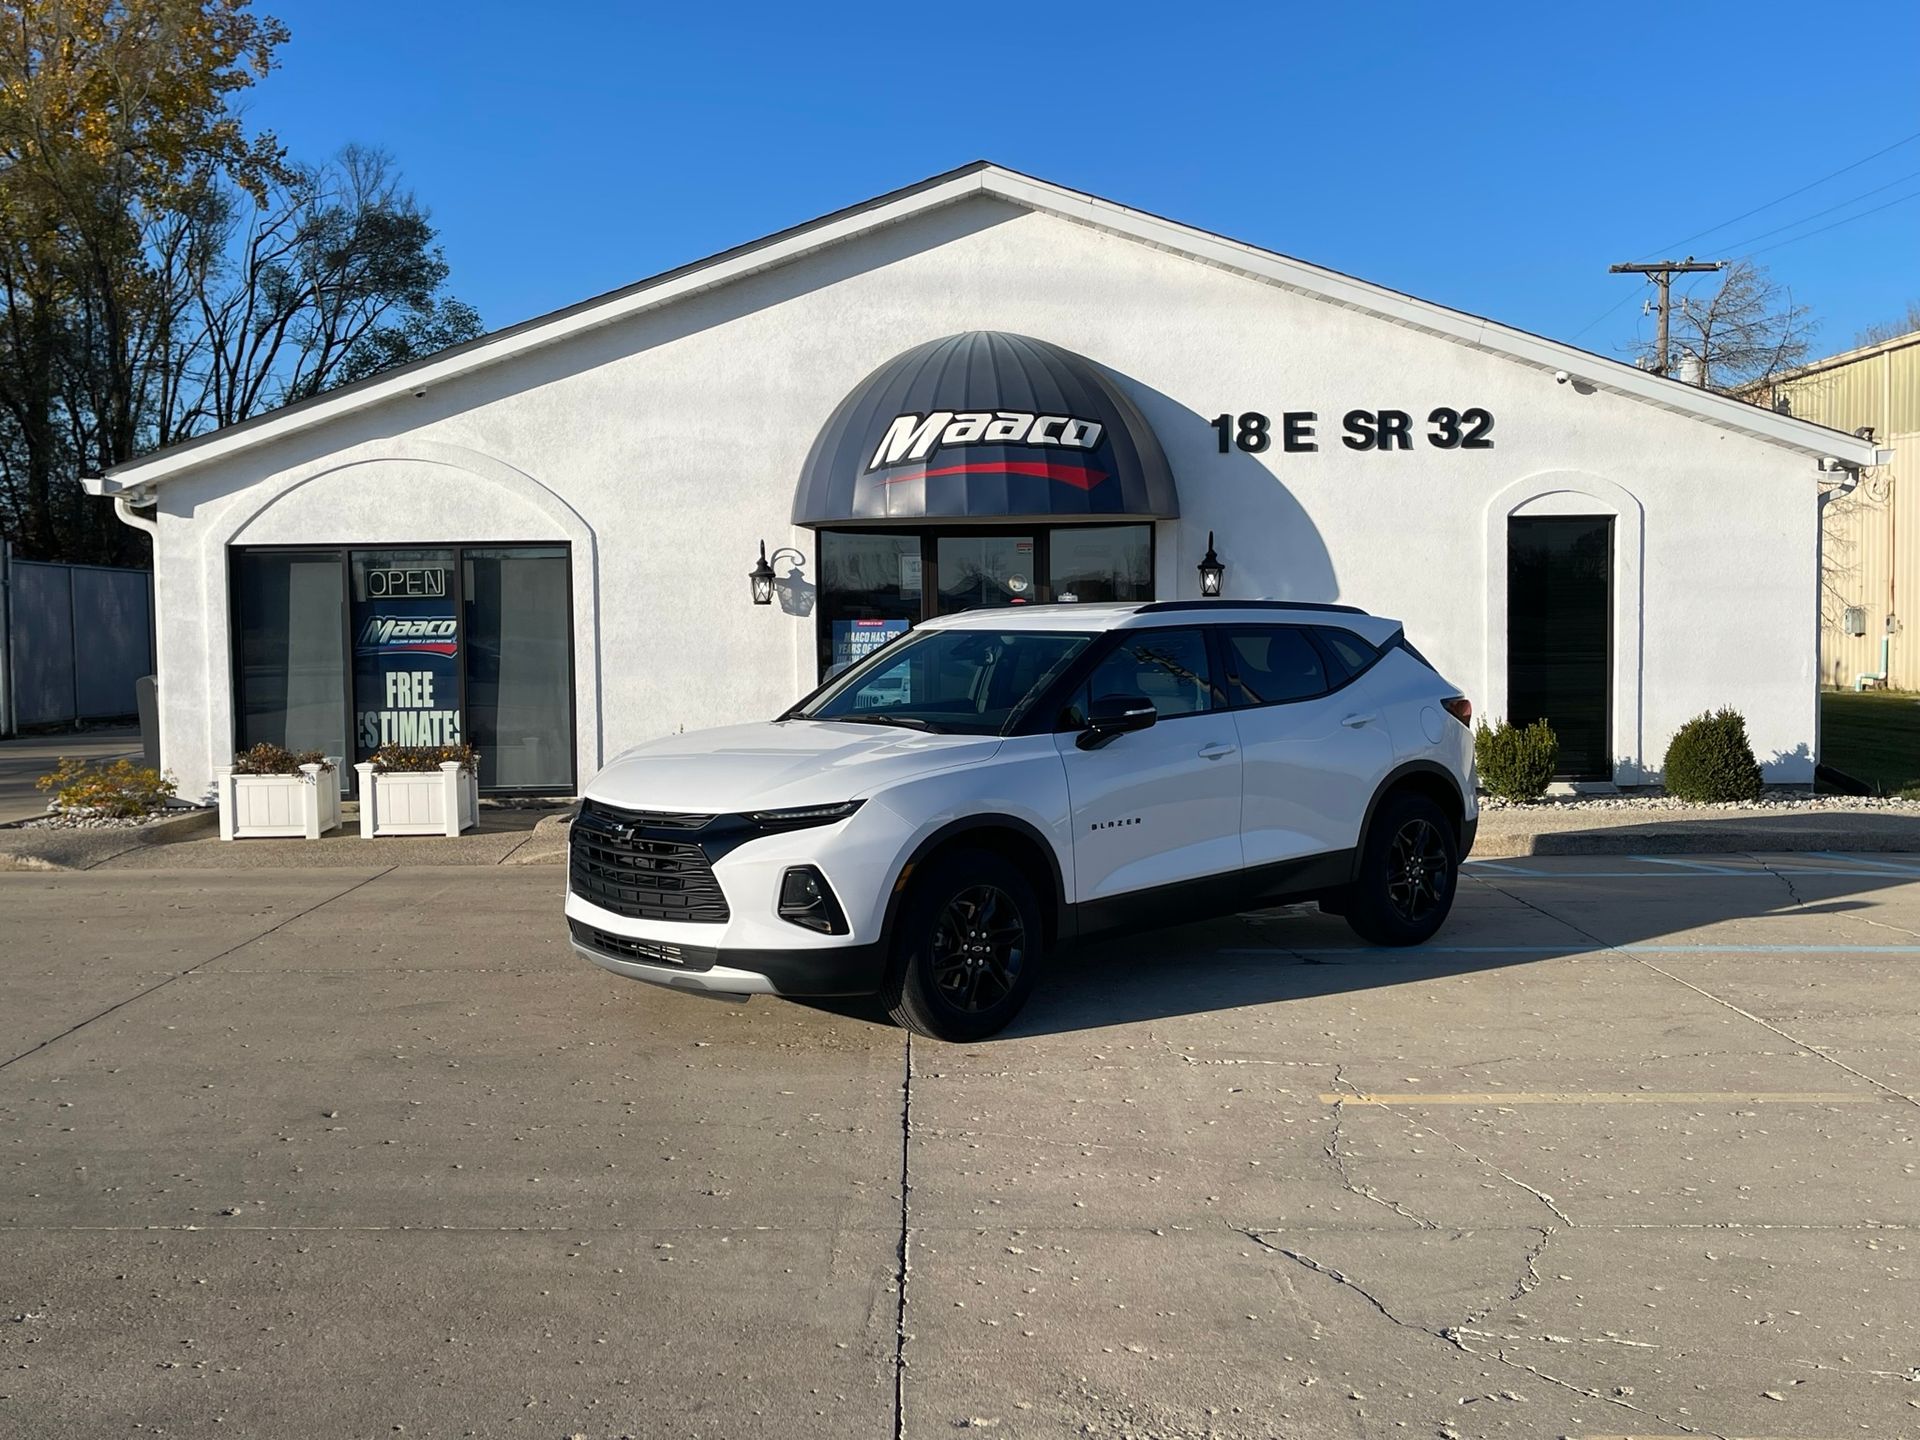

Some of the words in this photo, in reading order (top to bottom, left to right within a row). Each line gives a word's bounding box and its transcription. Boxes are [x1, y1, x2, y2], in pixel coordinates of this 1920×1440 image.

[869, 411, 1103, 470] Maaco
[1211, 411, 1271, 454] 18
[1283, 411, 1319, 452] E
[1342, 409, 1414, 451] SR
[1427, 407, 1495, 449] 32
[369, 570, 442, 595] OPEN
[362, 619, 458, 645] Maaco
[870, 631, 886, 643] HAS
[838, 643, 862, 654] YEARS
[386, 671, 434, 708] FREE
[1091, 818, 1141, 830] BLAZER
